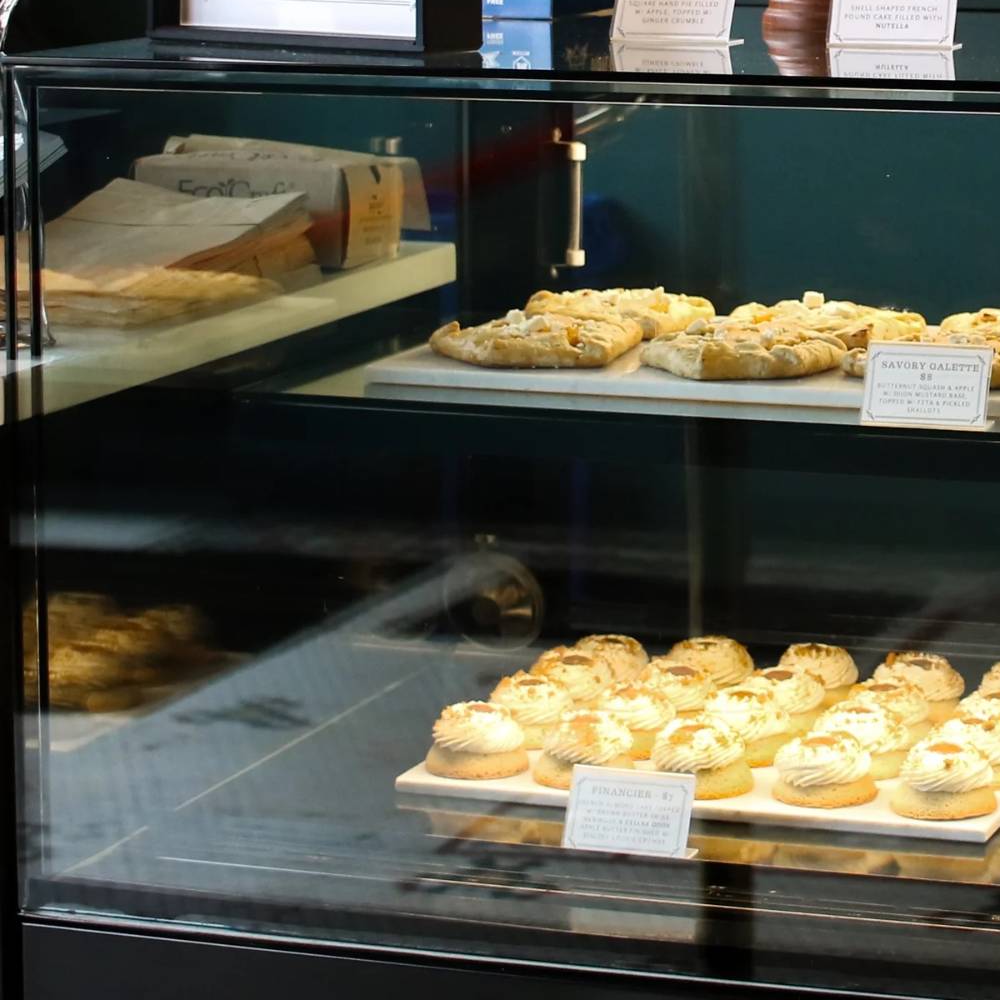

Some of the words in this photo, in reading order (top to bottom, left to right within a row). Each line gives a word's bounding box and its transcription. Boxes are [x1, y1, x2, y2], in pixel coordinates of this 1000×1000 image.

[881, 360, 926, 371] SAVORY
[929, 362, 980, 374] GALETTE
[592, 785, 652, 800] FINANCIER
